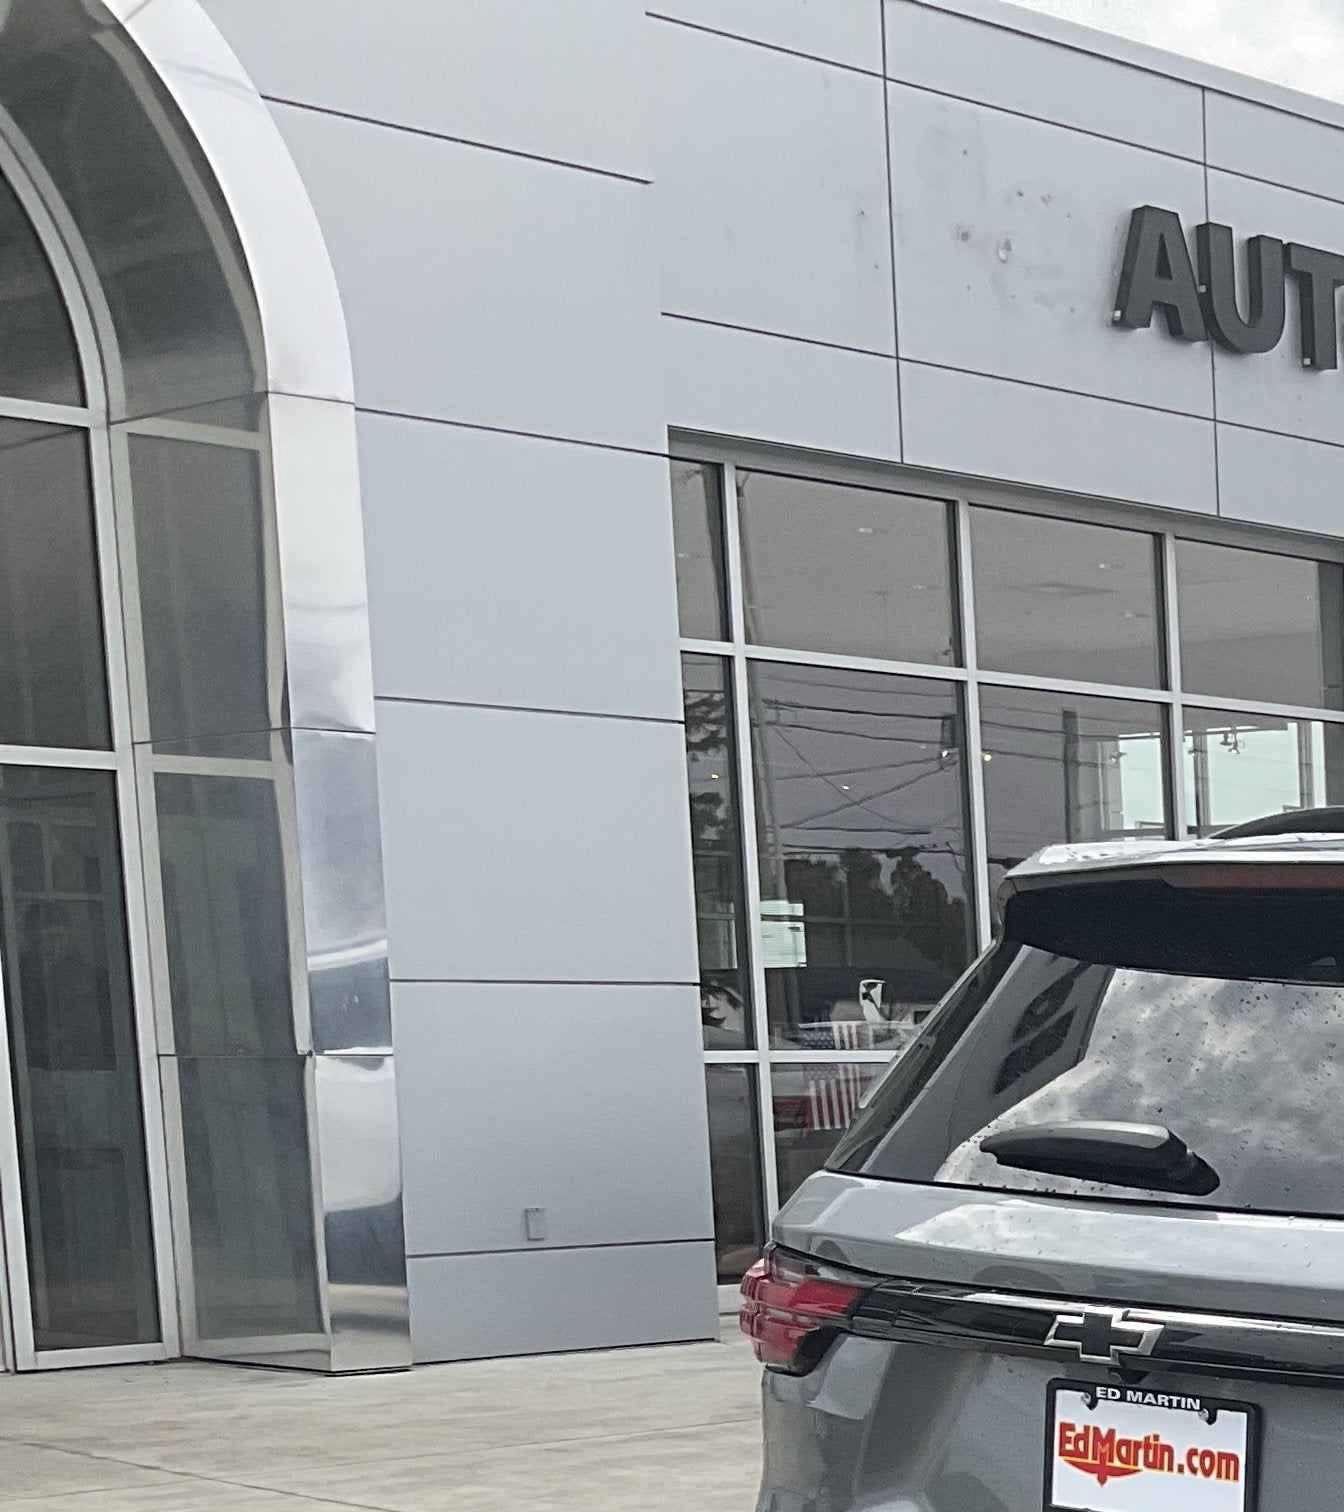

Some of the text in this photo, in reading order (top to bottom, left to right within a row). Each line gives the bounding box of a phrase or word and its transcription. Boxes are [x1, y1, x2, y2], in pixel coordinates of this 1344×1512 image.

[1096, 1386, 1201, 1410] ED MARTIN
[1058, 1421, 1240, 1483] EdMartin.com
